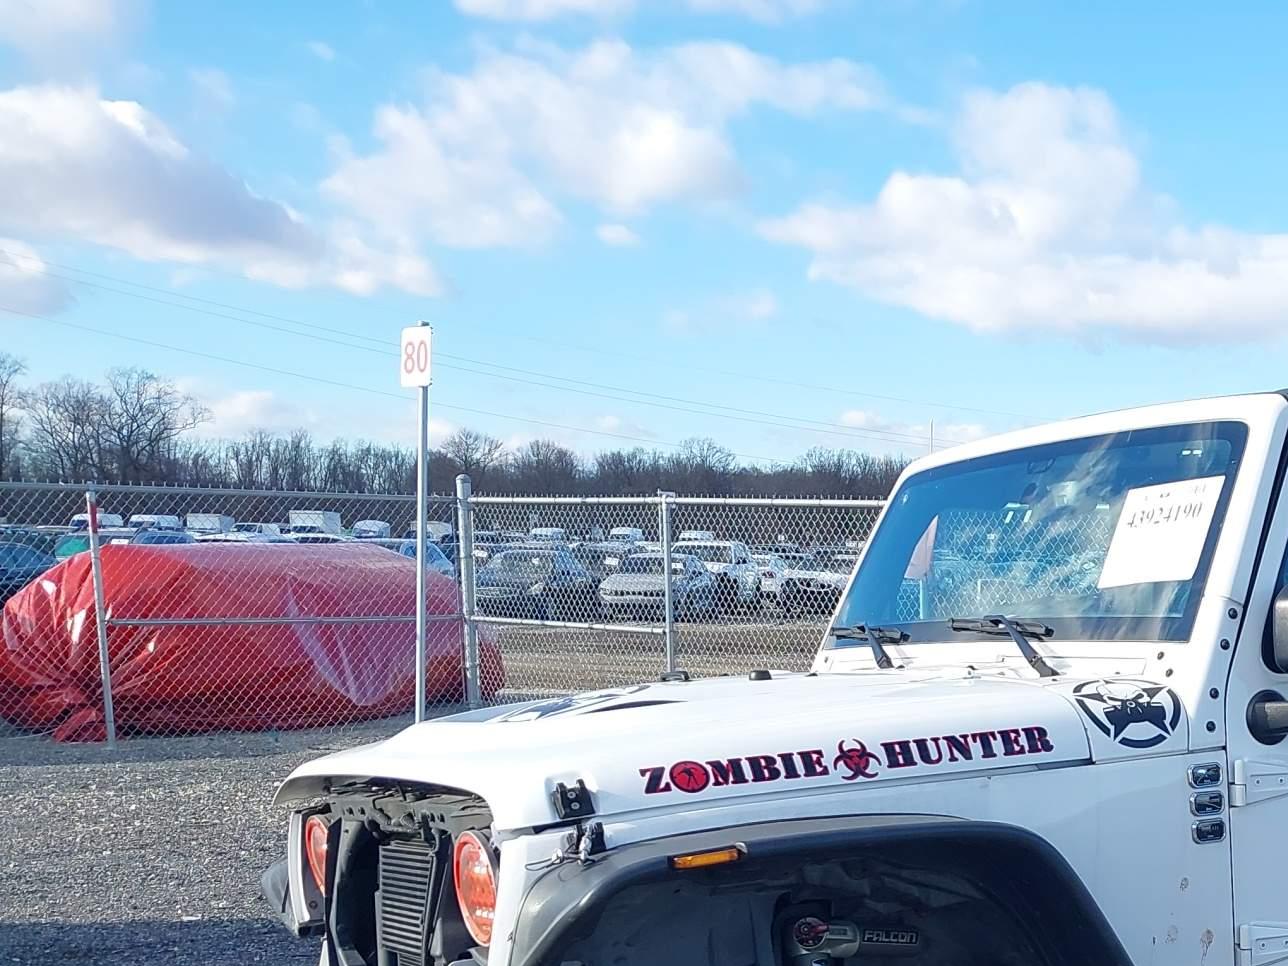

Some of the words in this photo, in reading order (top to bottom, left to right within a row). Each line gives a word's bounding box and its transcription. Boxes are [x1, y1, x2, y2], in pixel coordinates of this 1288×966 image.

[404, 340, 428, 374] 80
[1126, 501, 1204, 529] 43924190
[637, 748, 831, 796] ZOMBIE
[879, 724, 1056, 771] HUNTER
[863, 930, 917, 943] FALCON
